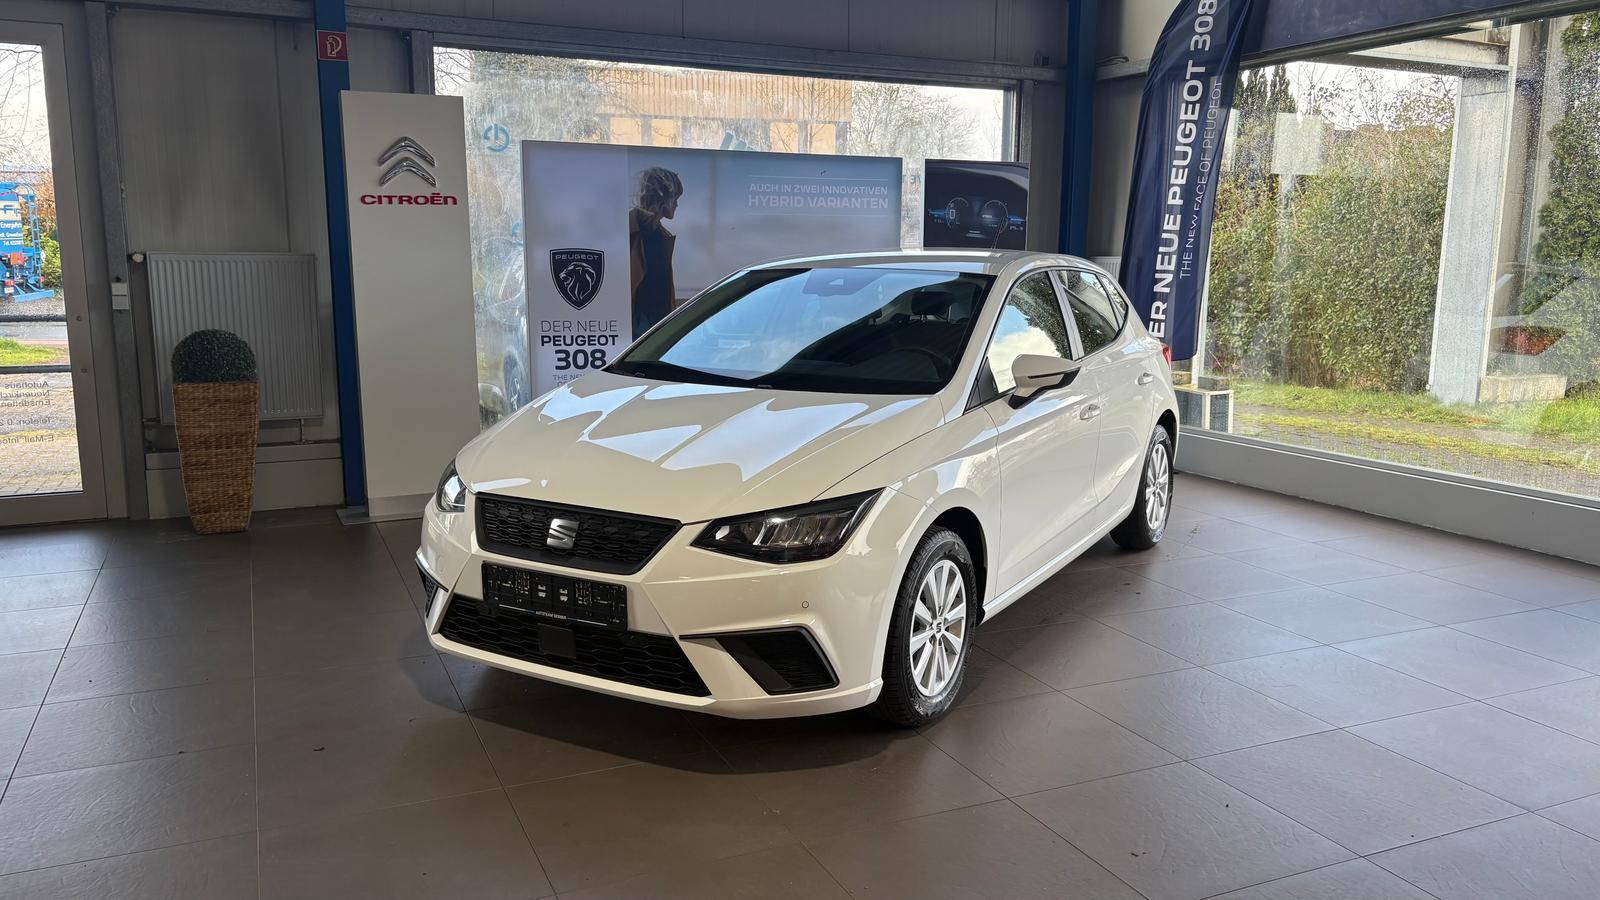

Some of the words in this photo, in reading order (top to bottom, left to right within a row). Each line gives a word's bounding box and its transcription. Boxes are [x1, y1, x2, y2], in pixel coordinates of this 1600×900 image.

[1190, 0, 1218, 51] 308
[1202, 80, 1222, 149] PEUGEOT
[1168, 60, 1206, 205] PEUGEOT
[1200, 152, 1212, 172] OF
[749, 195, 804, 208] HYBRID
[808, 197, 889, 209] VARIANTEN
[750, 183, 779, 193] AUCH
[781, 184, 791, 193] IN
[793, 185, 820, 194] ZWEI
[822, 186, 888, 195] INNOVATIVEN
[1194, 174, 1208, 211] FACE
[1185, 214, 1198, 248] NEW
[1153, 213, 1182, 293] NEUE
[1180, 252, 1193, 279] THE
[541, 320, 572, 333] DER
[577, 320, 617, 333] NEUE
[1150, 300, 1168, 338] ER
[541, 334, 619, 346] PEUGEOT
[554, 349, 607, 370] 308
